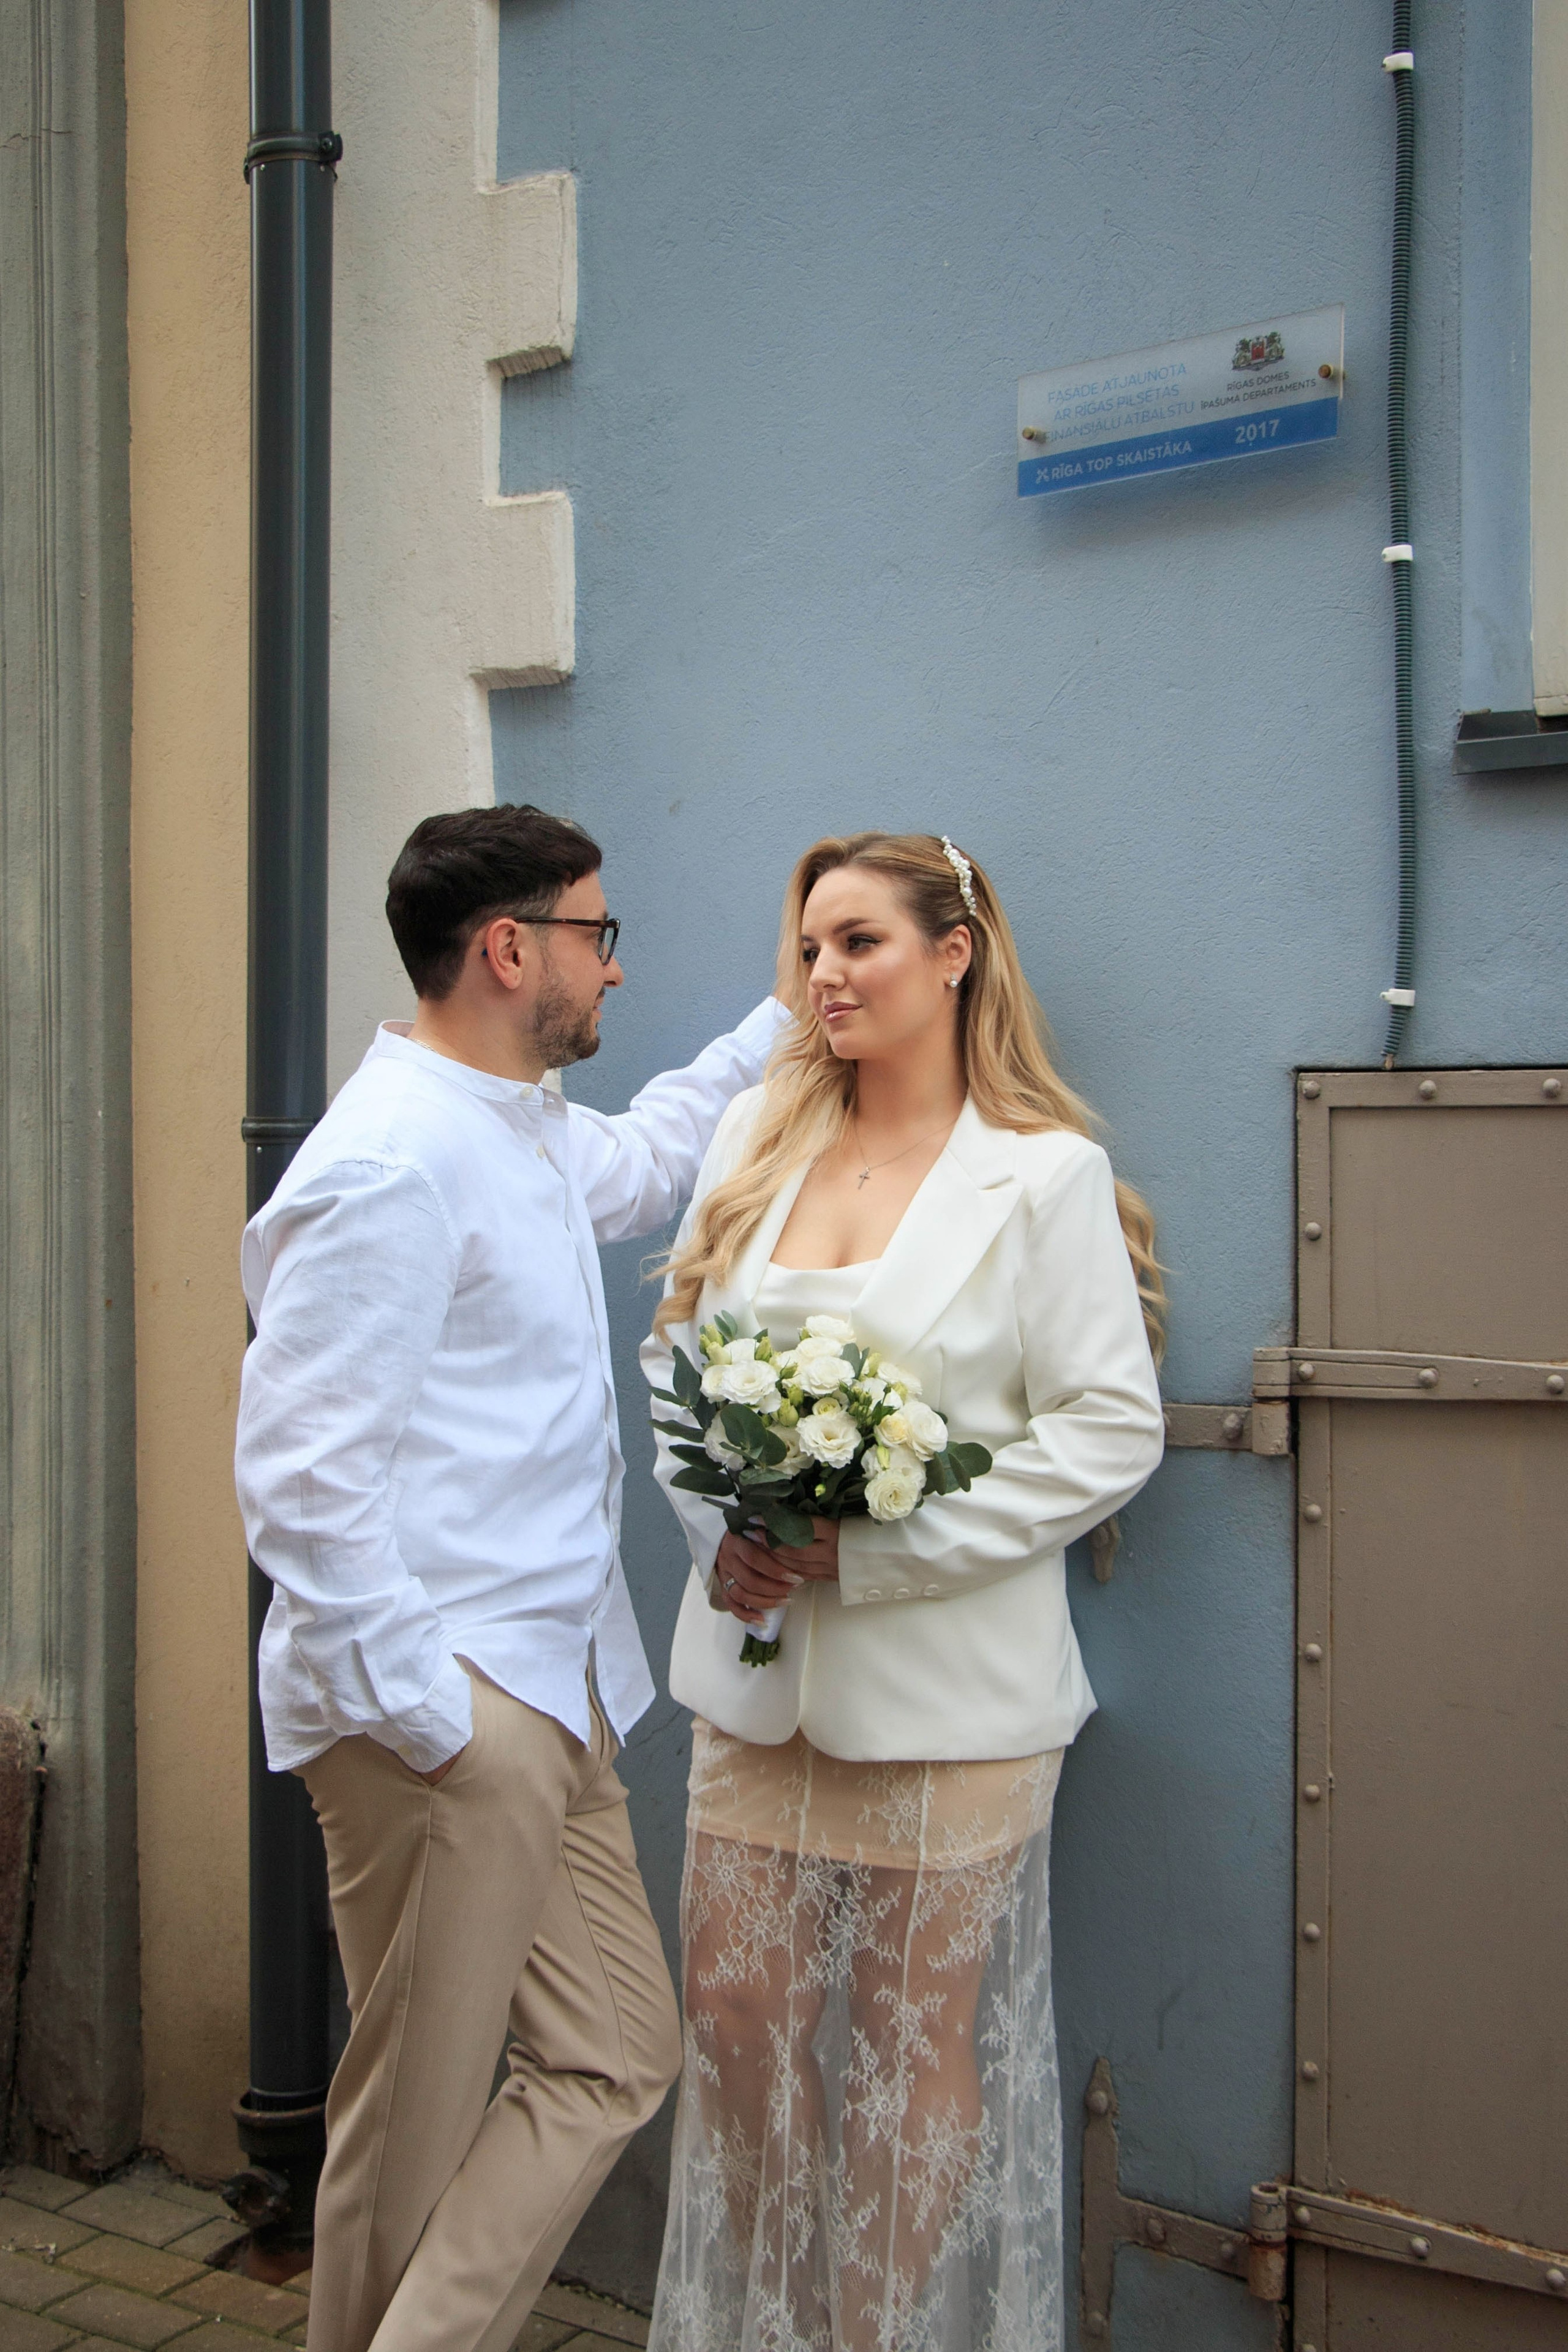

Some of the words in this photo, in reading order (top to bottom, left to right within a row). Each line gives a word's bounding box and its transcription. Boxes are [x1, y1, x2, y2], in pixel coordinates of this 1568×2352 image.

[1102, 363, 1187, 393] ATJAUNOTA
[1227, 378, 1254, 391] RĪGAS
[1256, 371, 1290, 385] DOMES
[1054, 408, 1071, 421] AR
[1075, 398, 1114, 418] RĪGAS
[1117, 384, 1180, 409] PILSĒTAS
[1200, 394, 1240, 410] ĪPAŠUMA
[1243, 379, 1316, 402] DEPARTAMENTS
[1125, 401, 1194, 425] ATBALSTU
[1235, 419, 1280, 444] 2017
[1051, 462, 1084, 480] RĪGA
[1087, 456, 1114, 472] TOP
[1116, 440, 1193, 467] SKAISTĀKA
